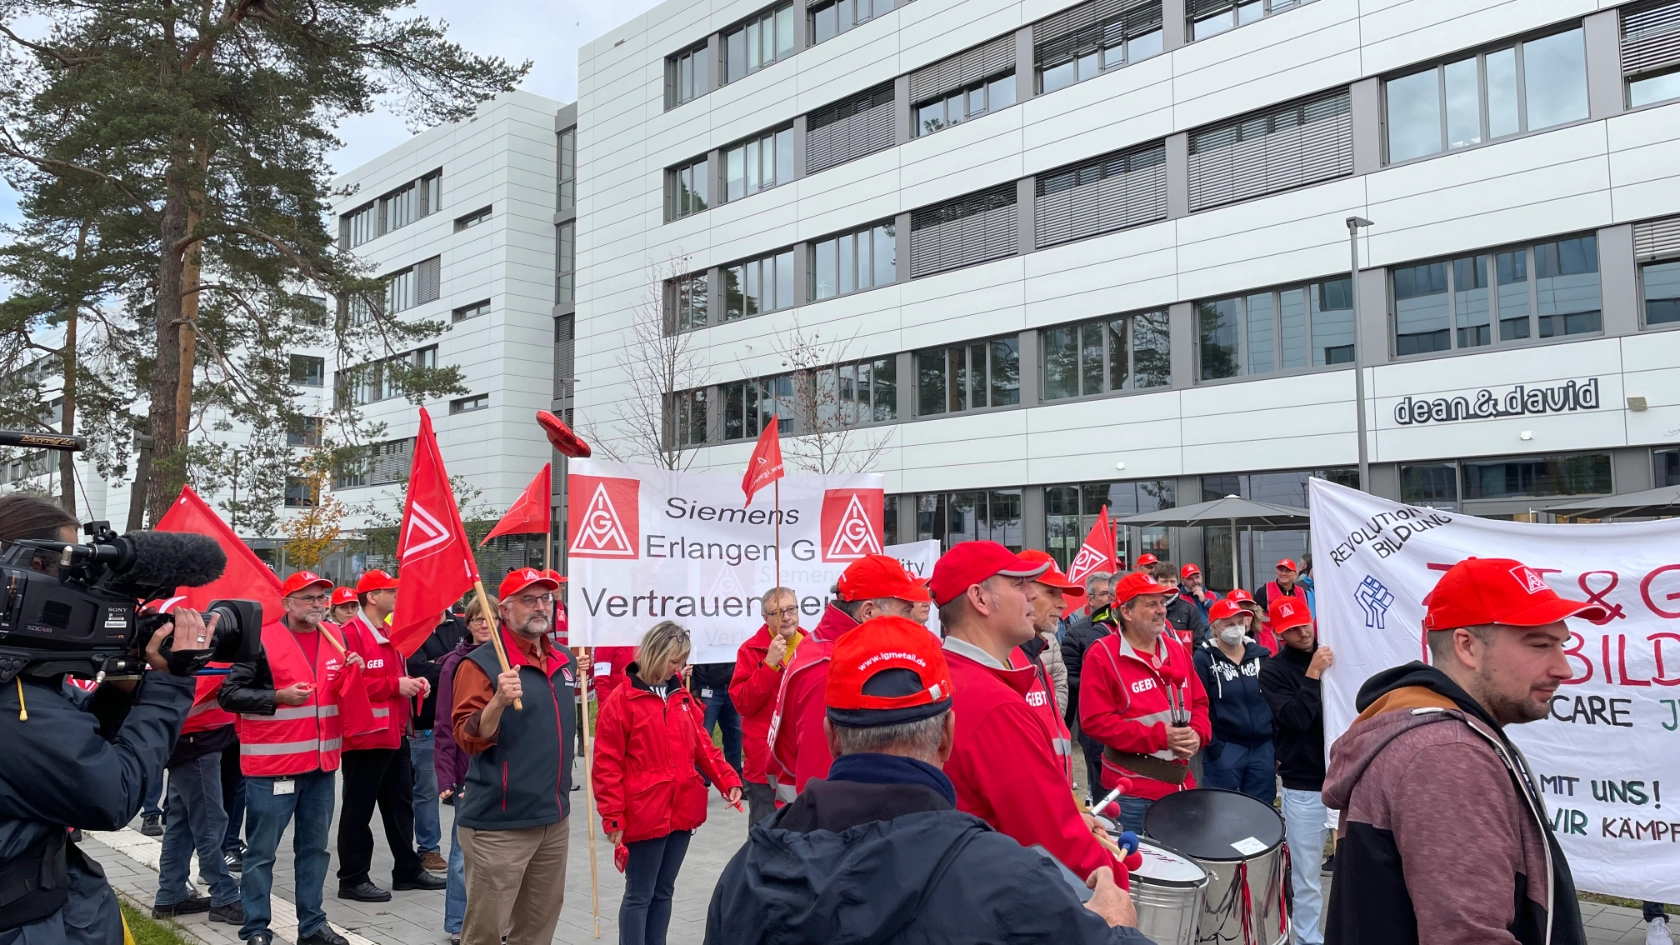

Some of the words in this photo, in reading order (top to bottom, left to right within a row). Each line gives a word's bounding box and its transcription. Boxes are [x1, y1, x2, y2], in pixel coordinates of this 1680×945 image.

[665, 497, 800, 526] Siemens
[646, 534, 778, 567] Erlangen
[791, 539, 816, 562] G
[1371, 513, 1453, 559] BILDUNG
[897, 558, 925, 577] ity
[857, 651, 927, 672] www.igmetall.de
[1539, 773, 1580, 797] MIT
[1590, 779, 1662, 810] UNS!
